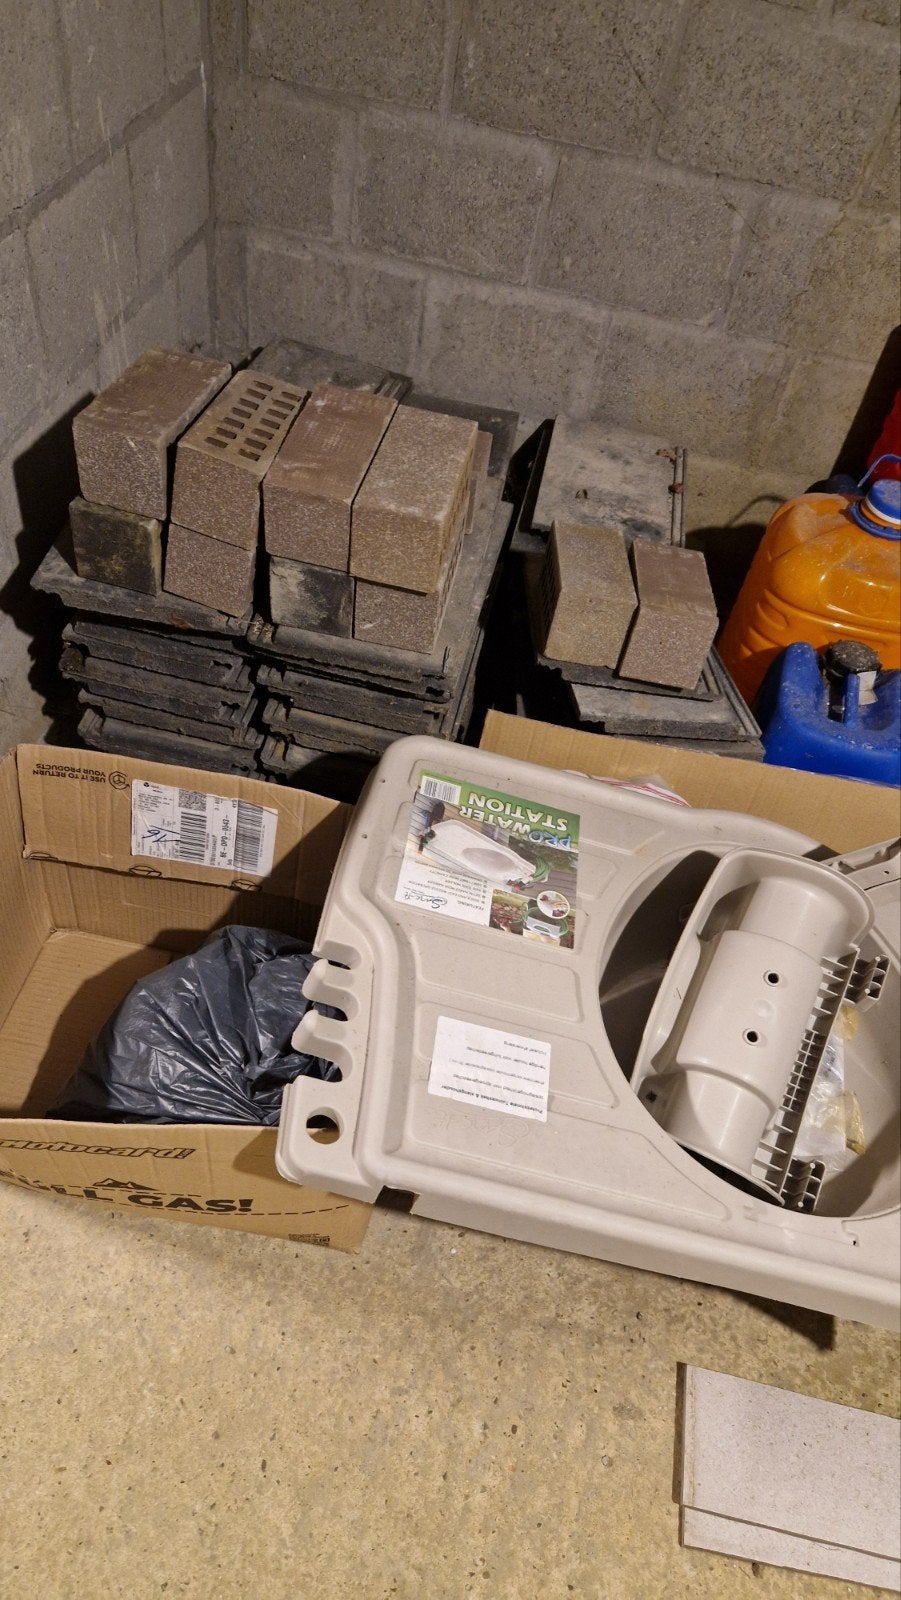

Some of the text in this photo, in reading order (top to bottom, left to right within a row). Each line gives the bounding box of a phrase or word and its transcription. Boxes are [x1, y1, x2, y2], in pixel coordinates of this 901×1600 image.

[33, 769, 66, 778] RETURN
[36, 763, 106, 777] YOUR PRODUCTS
[90, 775, 106, 783] USE
[468, 792, 568, 832] STATION
[459, 806, 572, 850] PRO WATER
[127, 1194, 254, 1212] GAS!
